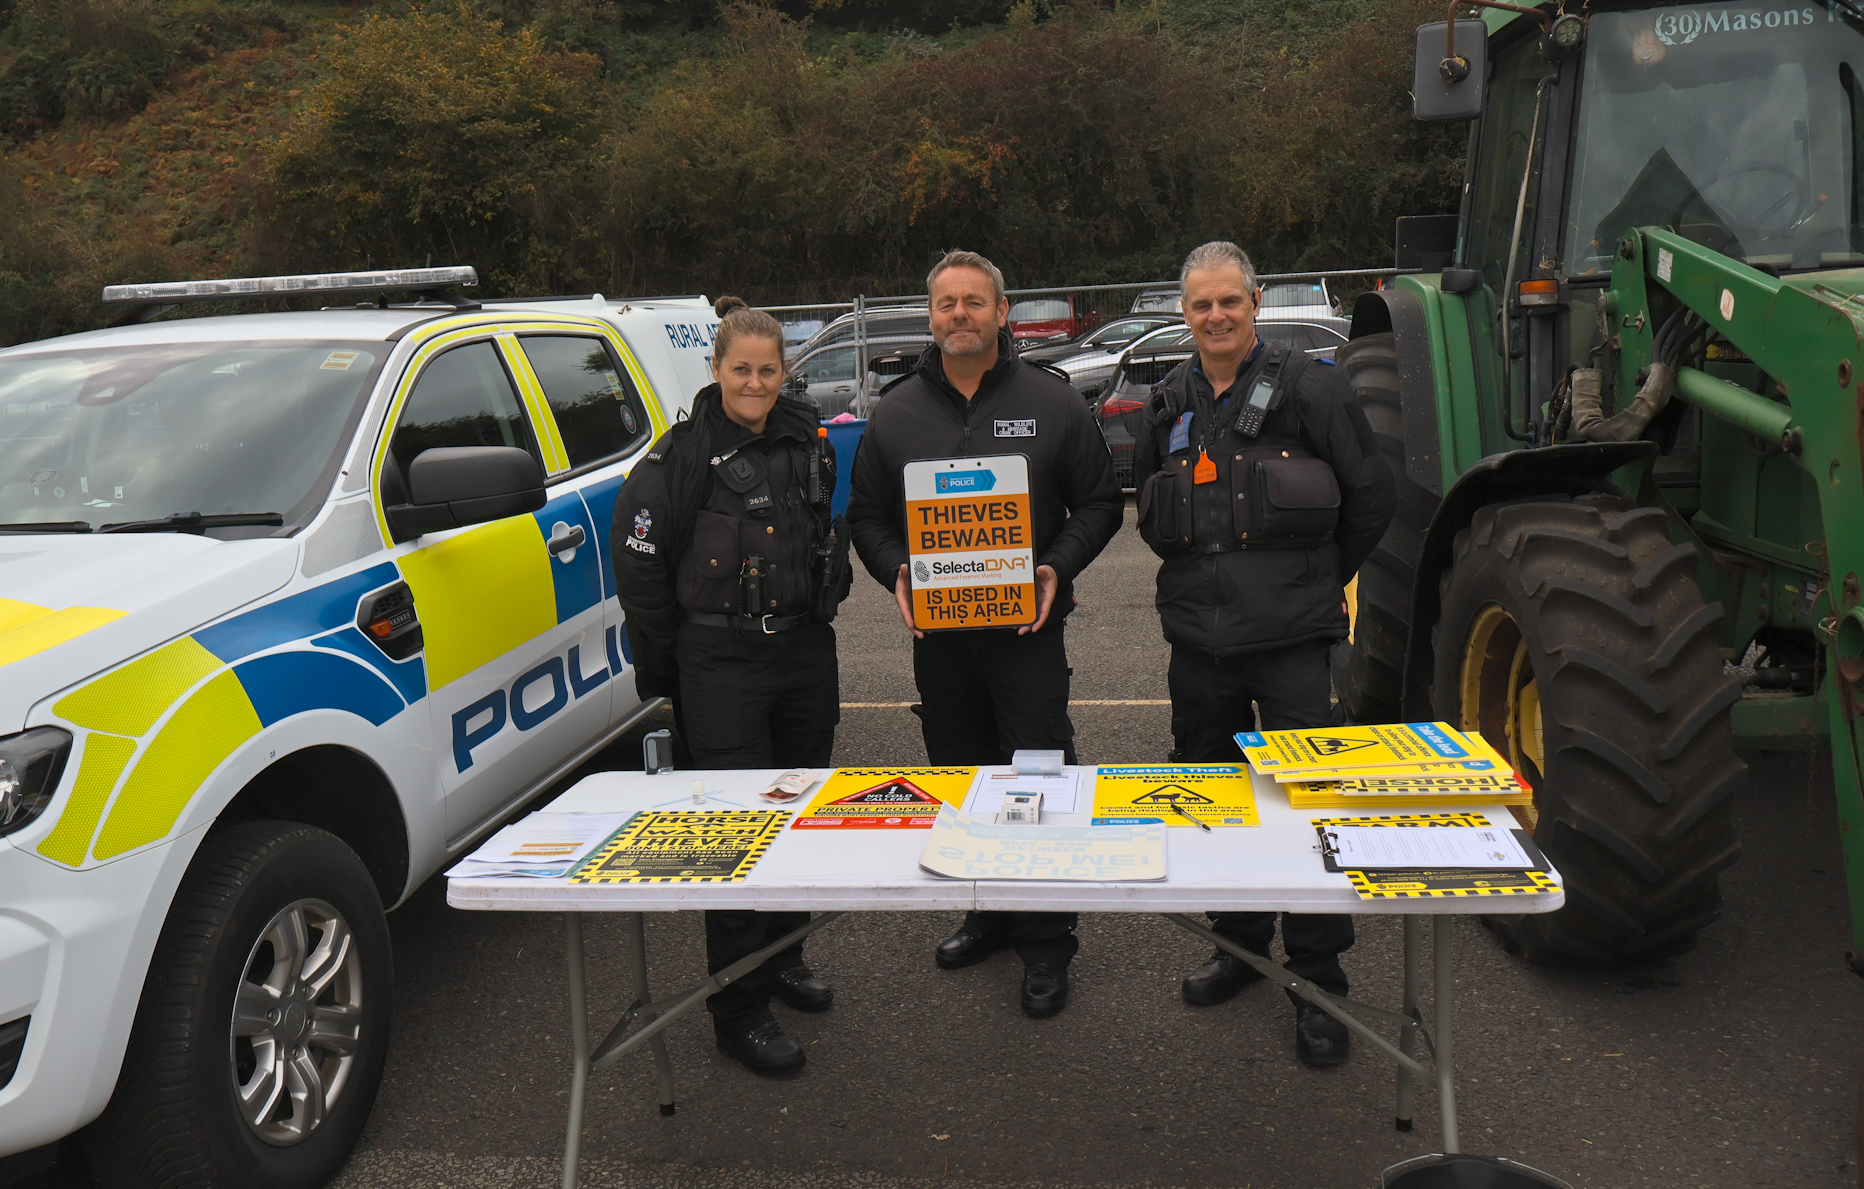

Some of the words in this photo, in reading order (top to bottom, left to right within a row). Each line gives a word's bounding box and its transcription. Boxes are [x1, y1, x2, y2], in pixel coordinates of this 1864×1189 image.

[1665, 14, 1694, 36] 30
[1704, 7, 1814, 34] Masons
[664, 324, 709, 348] RURAL
[647, 452, 662, 460] 2634
[950, 478, 975, 487] POLICE
[749, 495, 769, 505] 2634
[918, 501, 1019, 525] THIEVES
[920, 526, 1023, 550] BEWARE
[626, 539, 656, 555] POLICE
[926, 589, 944, 605] IS
[948, 587, 998, 603] USED
[1004, 586, 1022, 600] IN
[926, 604, 969, 620] THIS
[973, 601, 1024, 618] AREA
[1416, 725, 1438, 738] Take
[1426, 734, 1447, 744] the
[1436, 742, 1460, 755] lead
[1366, 777, 1490, 786] HORSE
[656, 816, 768, 824] HORSE
[631, 837, 756, 846] THIEVES
